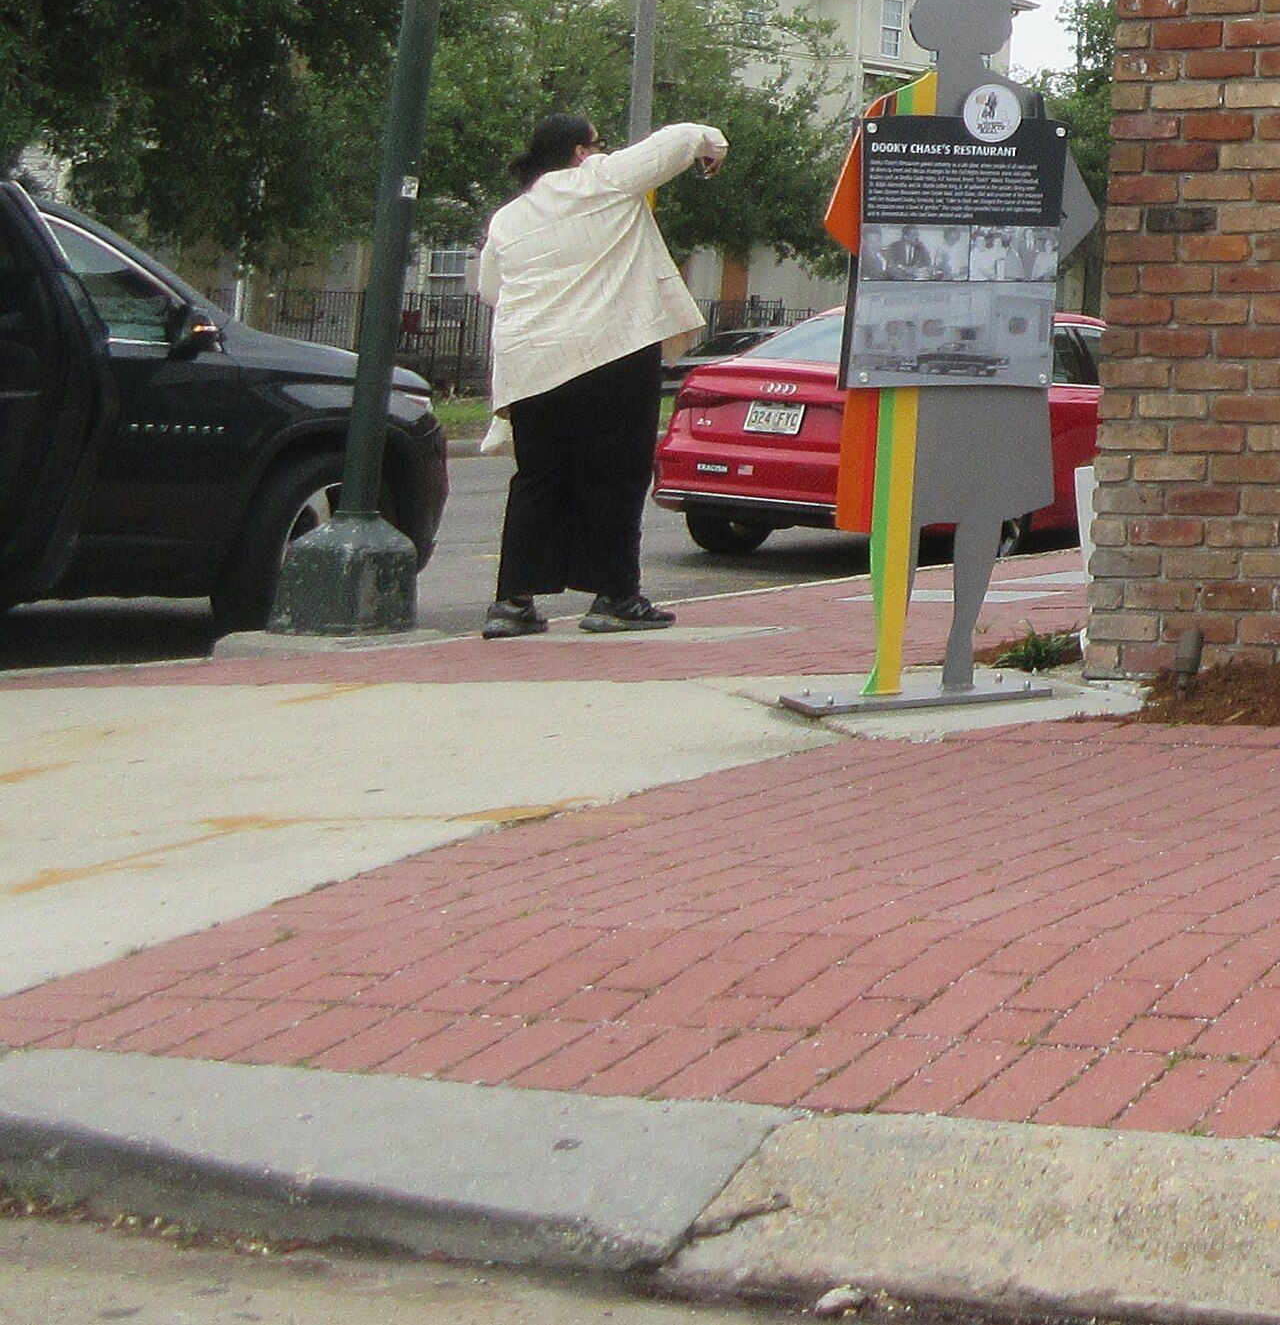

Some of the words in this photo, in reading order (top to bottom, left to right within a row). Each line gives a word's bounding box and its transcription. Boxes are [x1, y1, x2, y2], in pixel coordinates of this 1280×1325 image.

[871, 142, 907, 154] DOOKY
[910, 143, 951, 155] CHASE'S
[953, 145, 1017, 157] RESTAURANT
[751, 410, 772, 424] 324
